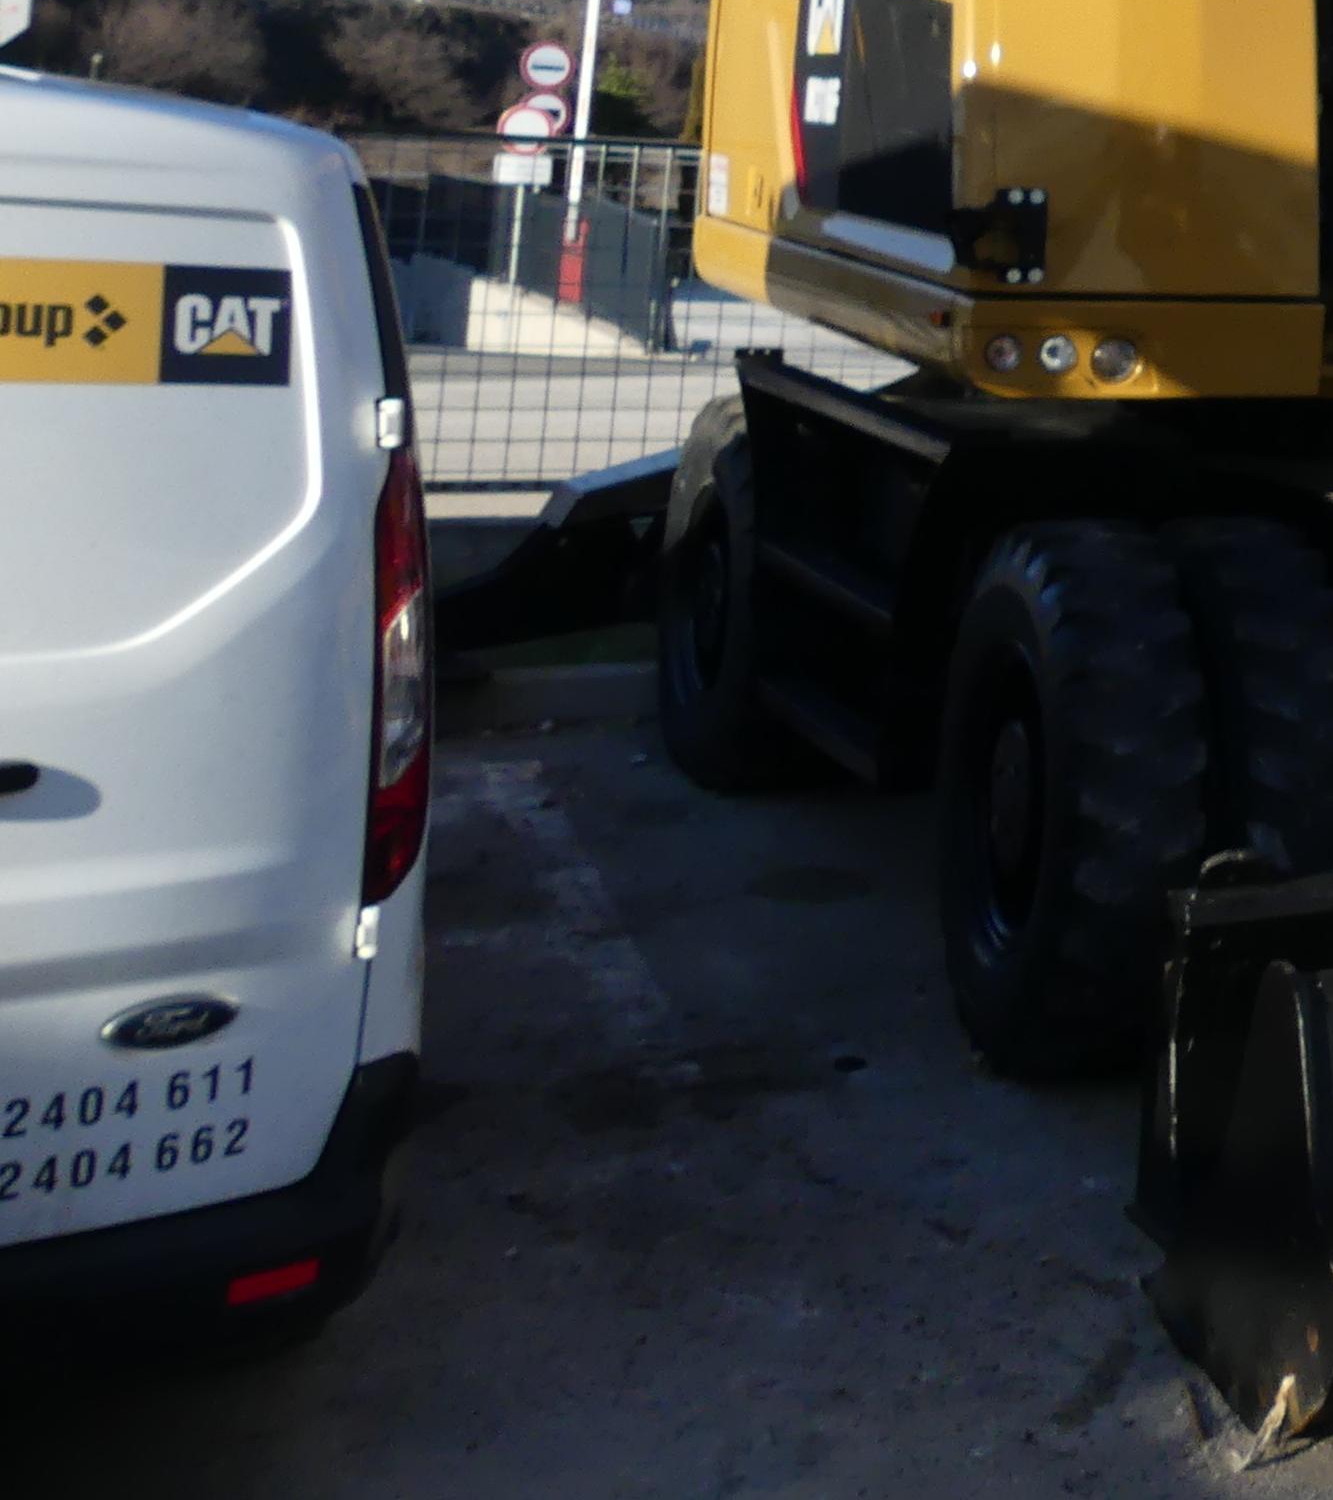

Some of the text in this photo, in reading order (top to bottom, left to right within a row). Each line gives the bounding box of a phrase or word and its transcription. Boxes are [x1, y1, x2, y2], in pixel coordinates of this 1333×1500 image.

[174, 293, 281, 356] CAT
[2, 1055, 255, 1139] 2404 611
[0, 1117, 249, 1200] 2404 662
